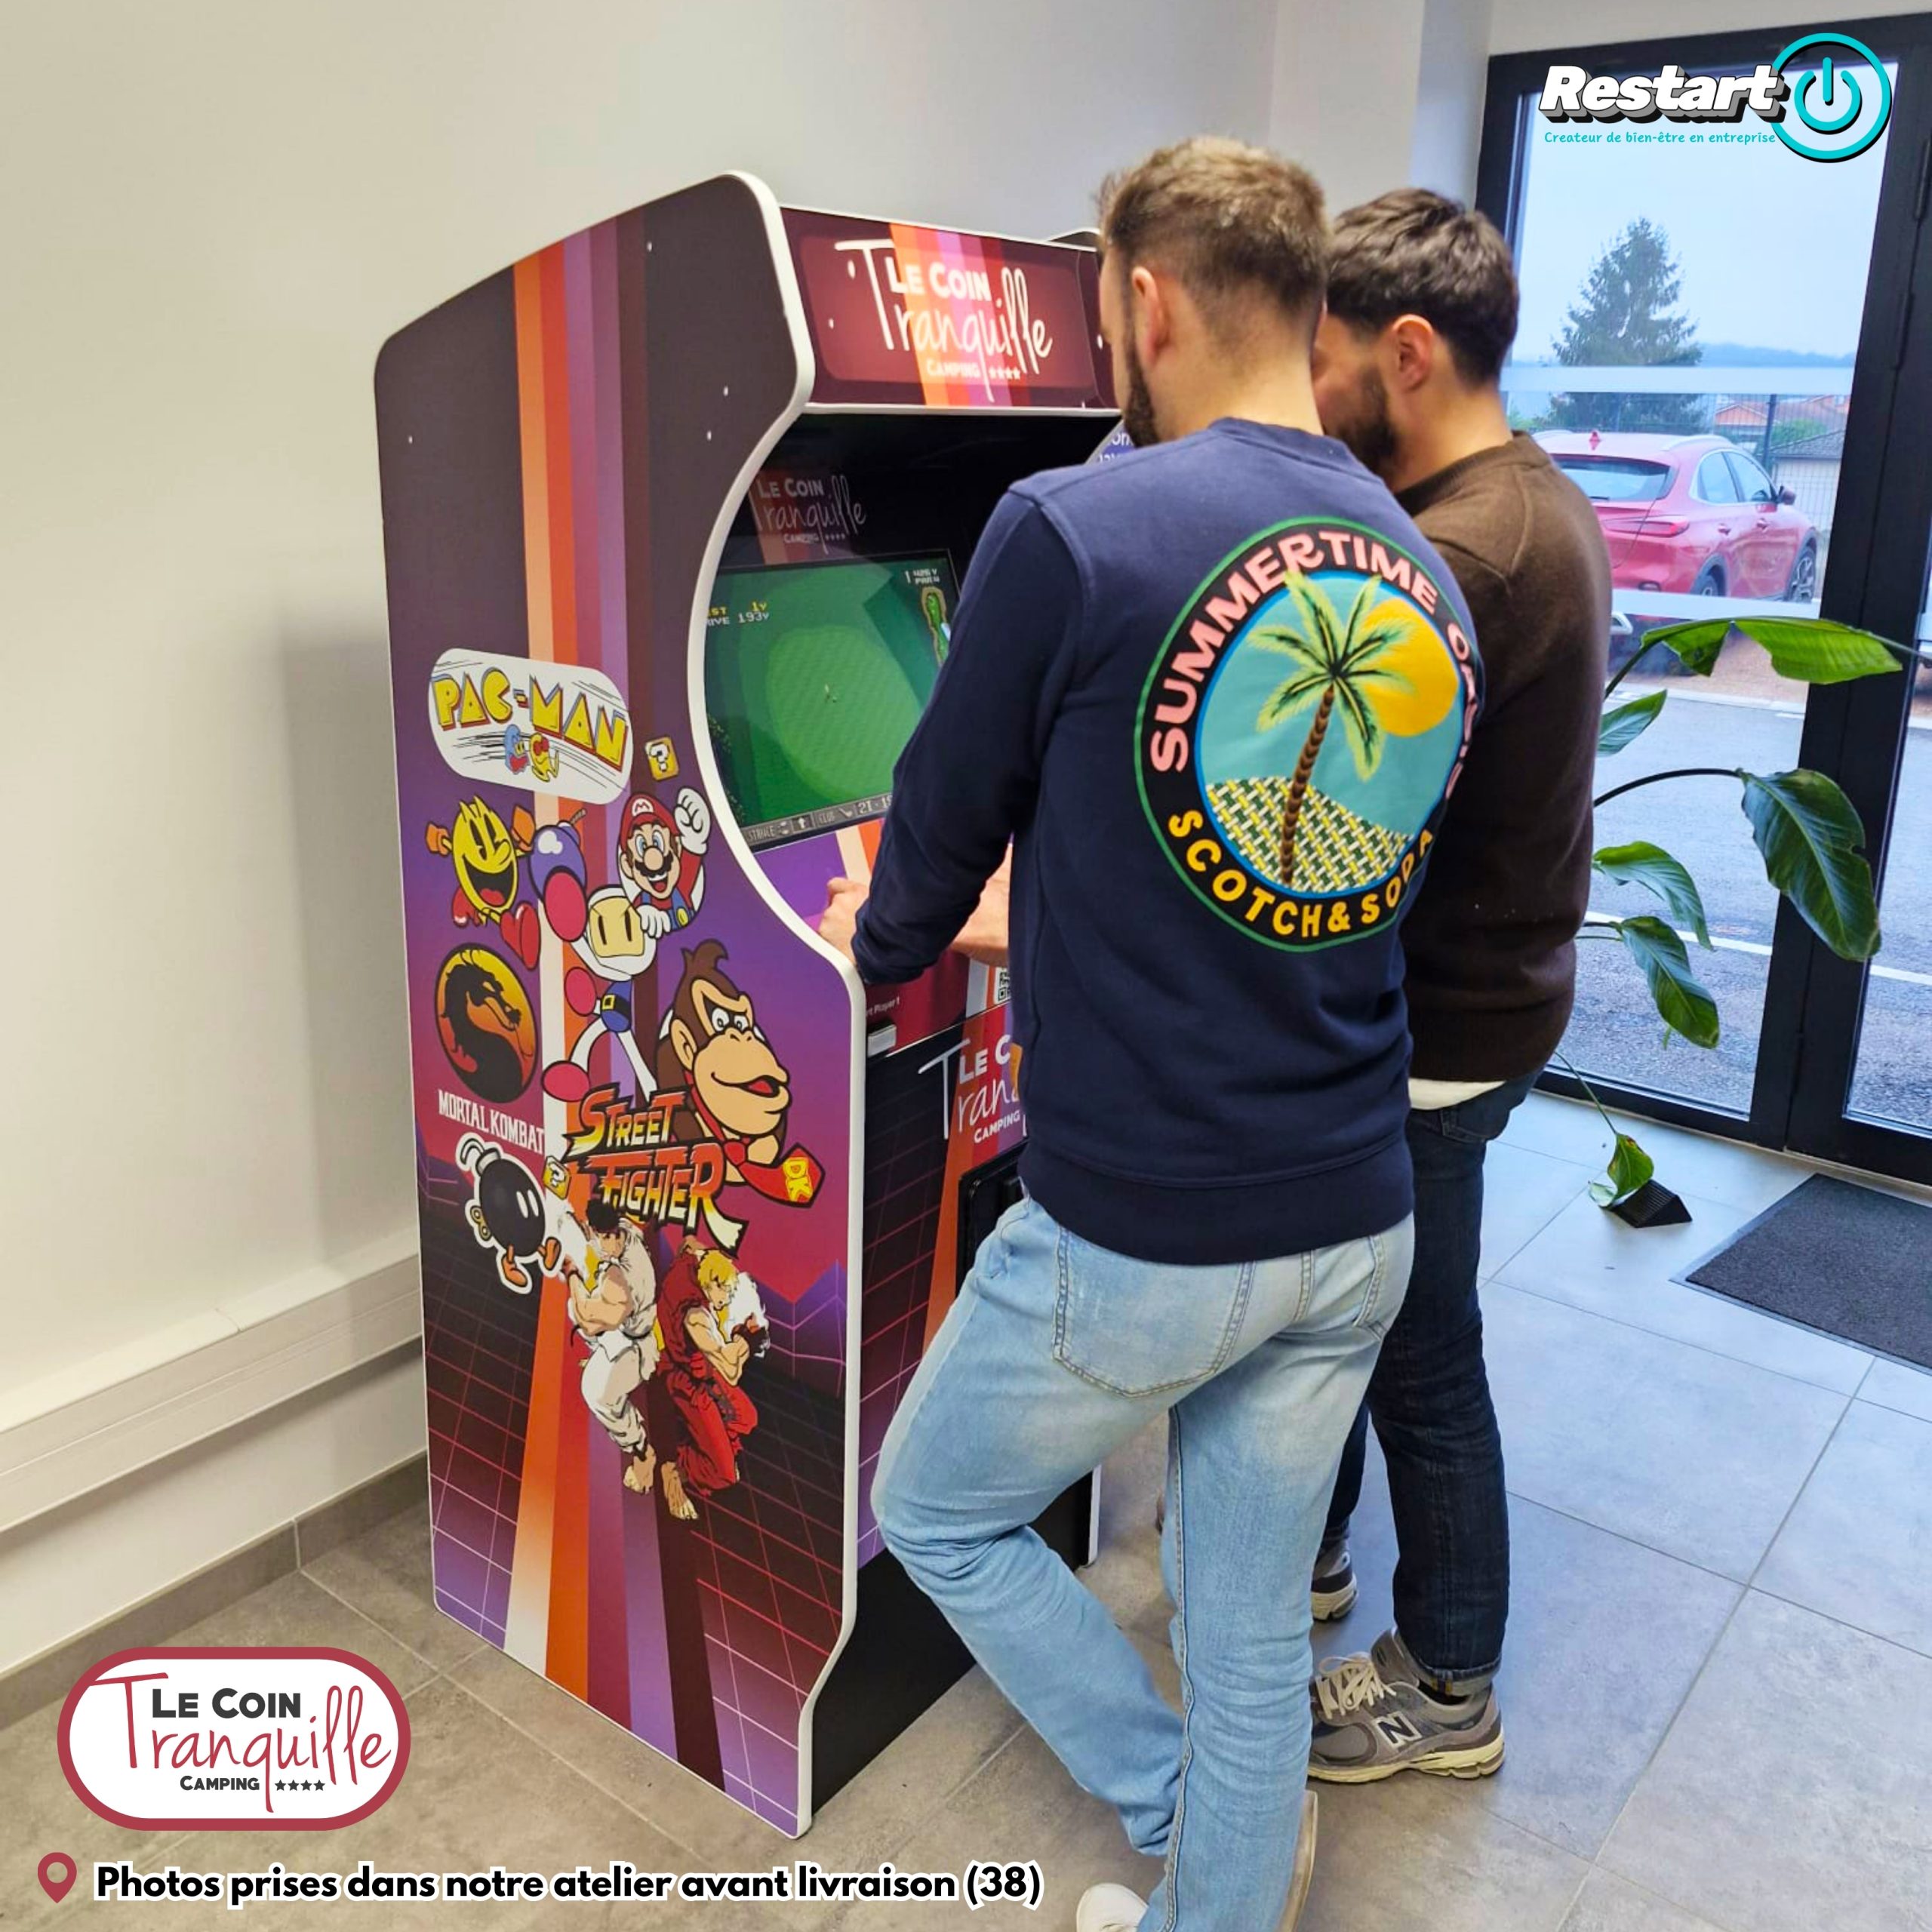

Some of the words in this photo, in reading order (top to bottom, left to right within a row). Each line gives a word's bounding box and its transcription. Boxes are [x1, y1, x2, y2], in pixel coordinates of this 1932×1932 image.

[834, 238, 1053, 402] Tranquille
[1149, 530, 1439, 774] SUMMERTIME
[431, 667, 629, 773] PAC-MAN
[438, 1088, 490, 1133] MORTAL
[490, 1108, 545, 1156] KOMBAT
[566, 1087, 687, 1158] STREET
[974, 1109, 1020, 1143] CAMPING
[584, 1142, 744, 1251] FIGHTER
